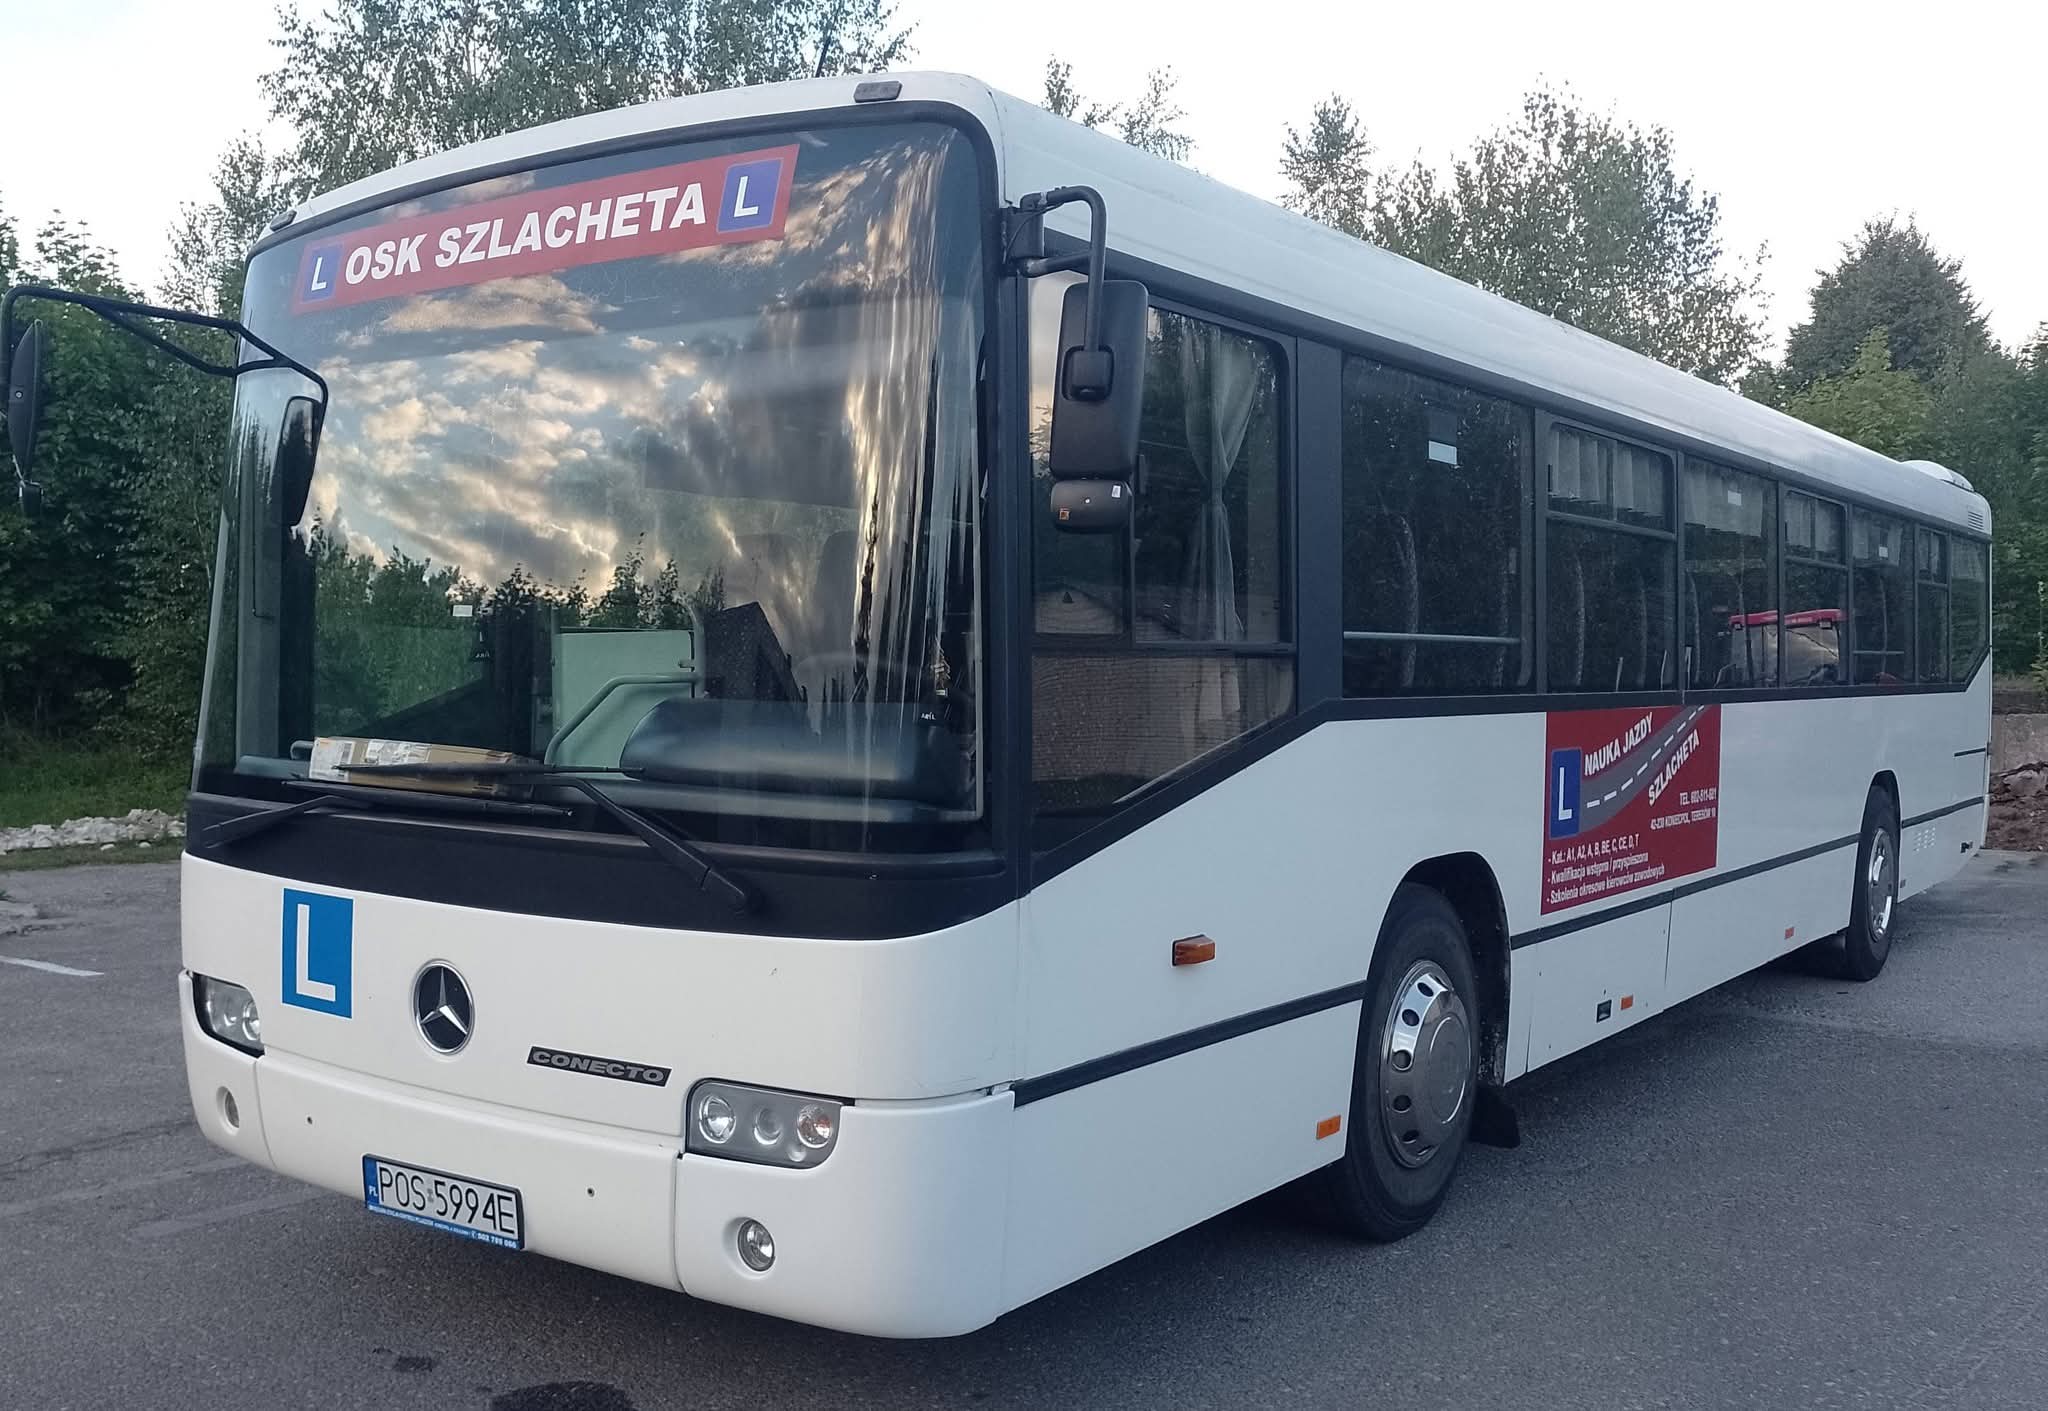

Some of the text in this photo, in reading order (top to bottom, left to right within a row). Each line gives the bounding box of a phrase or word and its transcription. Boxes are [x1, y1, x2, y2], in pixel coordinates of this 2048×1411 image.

[311, 174, 761, 292] L OSK SZLACHETA L
[1584, 712, 1653, 776] NAUKA JAZDY
[1648, 729, 1700, 806] SZLACHETA
[1558, 767, 1573, 821] L
[296, 903, 336, 1002] L
[532, 1051, 664, 1082] CONECTO
[369, 1186, 378, 1197] PL
[379, 1167, 426, 1211] POS
[434, 1180, 515, 1234] 5994E
